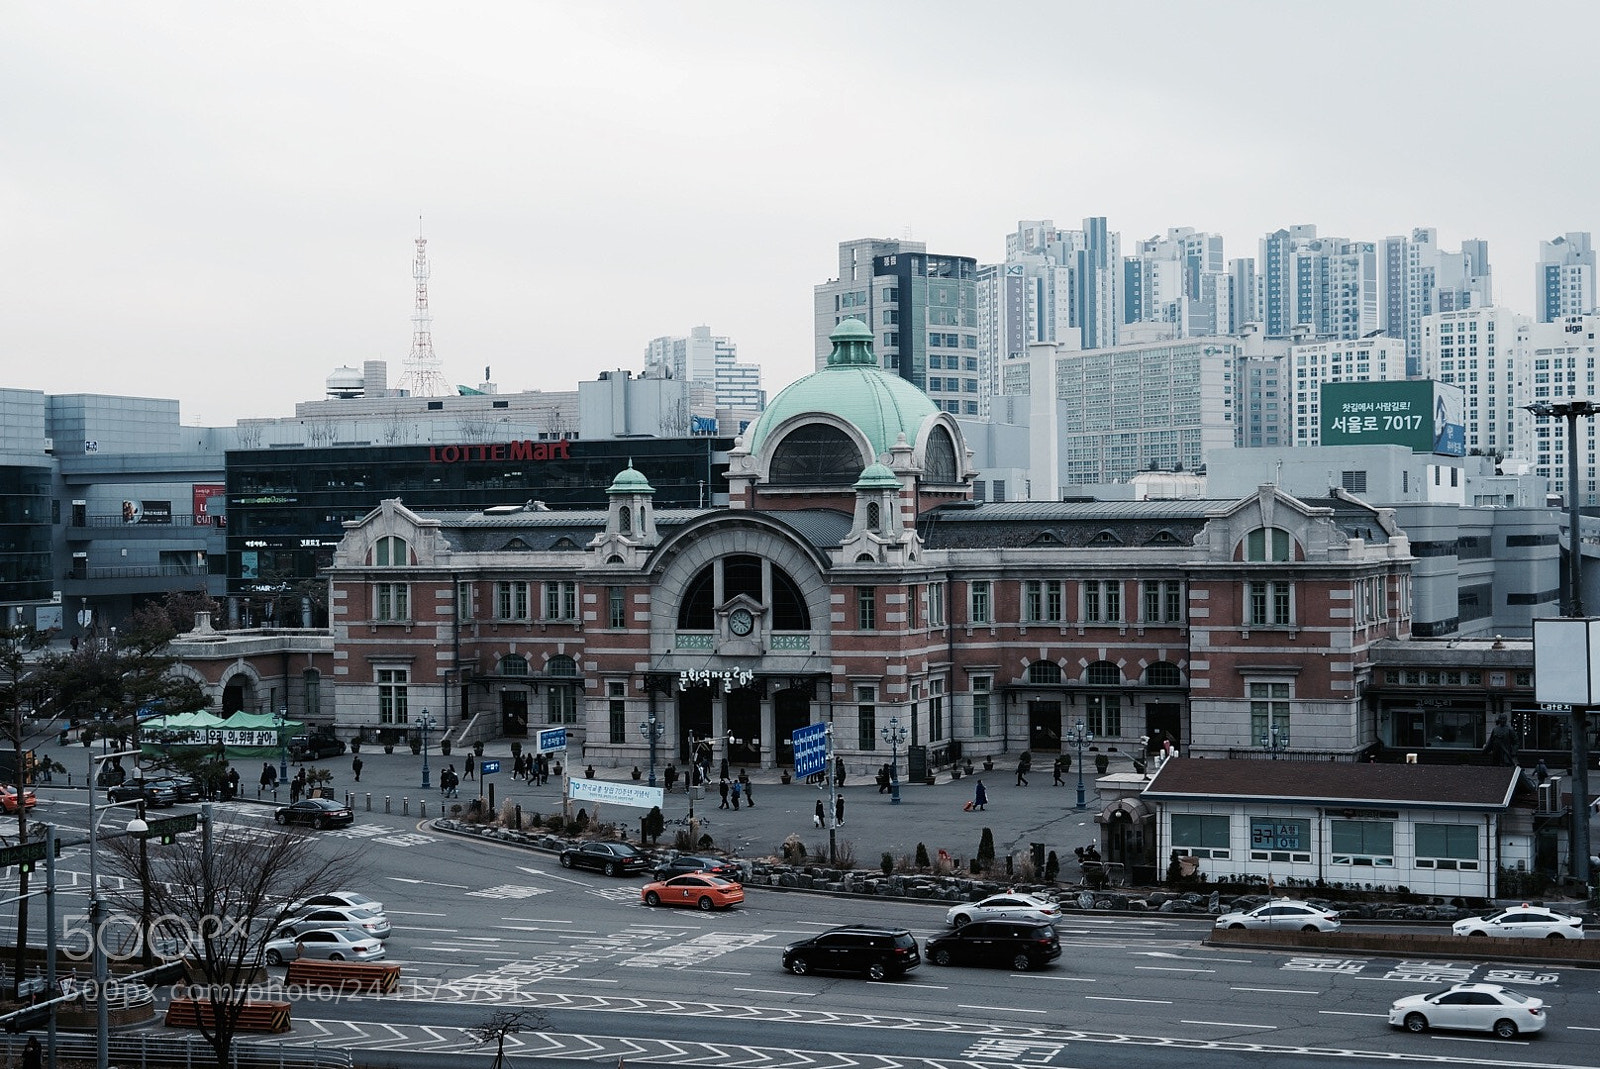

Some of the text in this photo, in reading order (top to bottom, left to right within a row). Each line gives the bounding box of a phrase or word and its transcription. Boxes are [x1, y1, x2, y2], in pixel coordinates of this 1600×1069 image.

[1375, 401, 1411, 412] 사람길로!
[1331, 415, 1423, 434] 서울로 7017
[429, 439, 570, 464] LOTTE Mart
[1253, 829, 1273, 844] 급구
